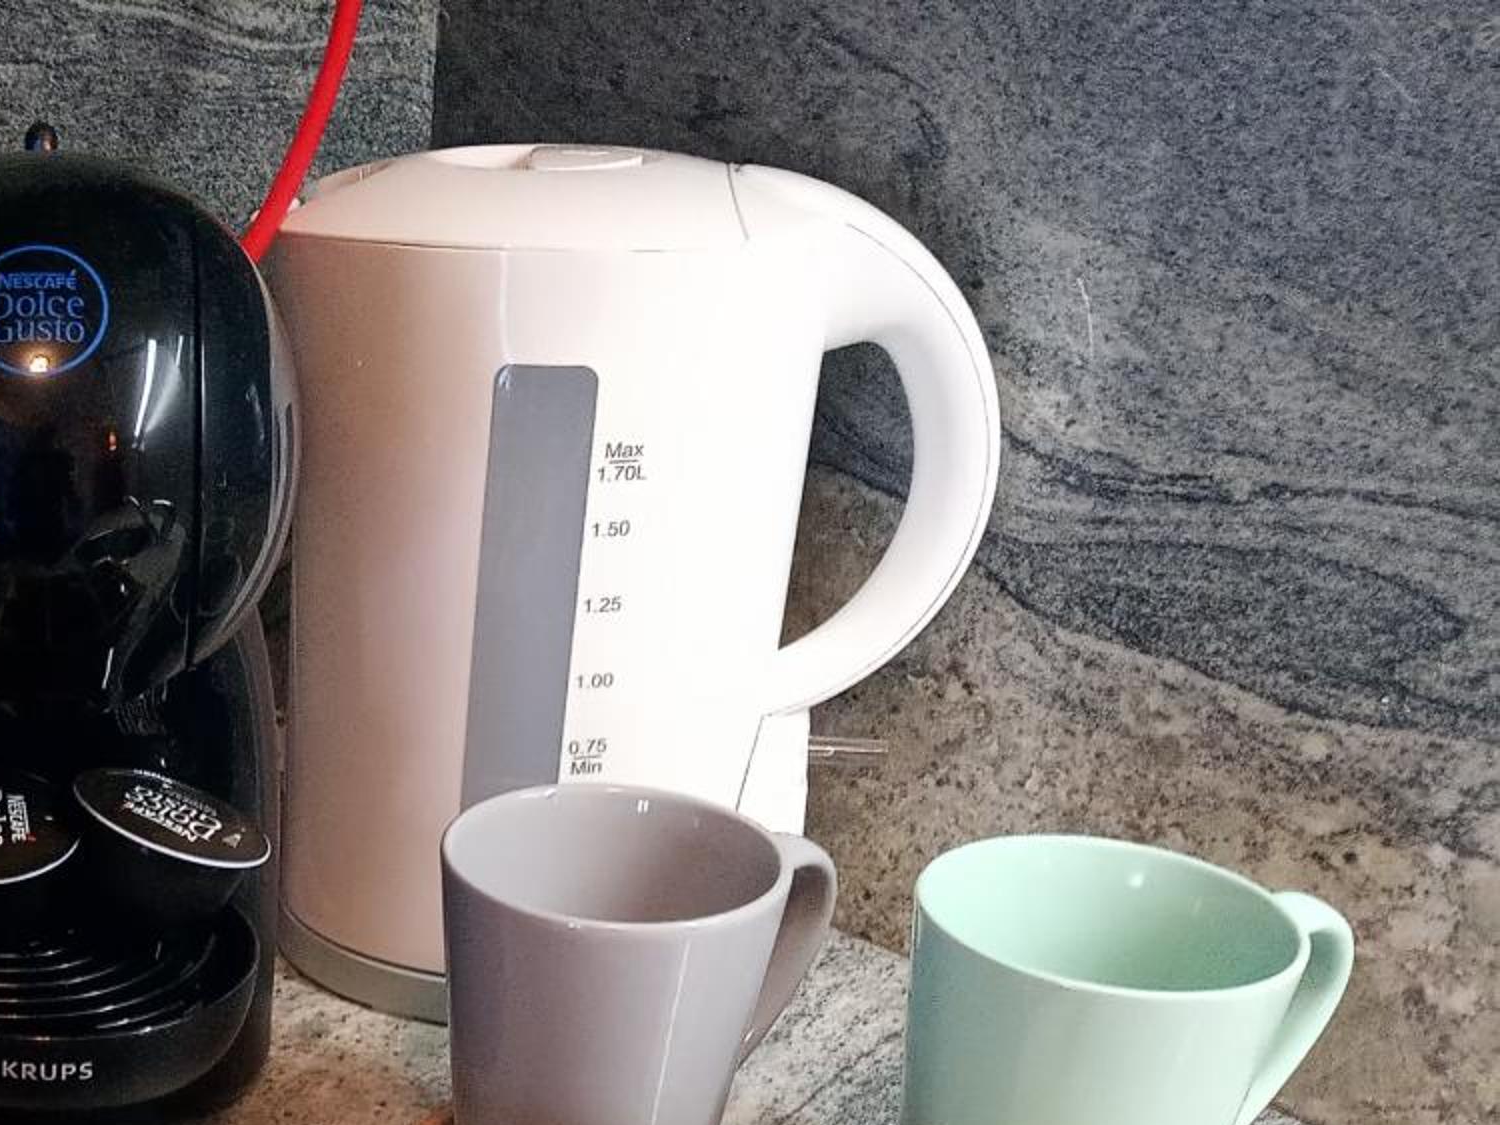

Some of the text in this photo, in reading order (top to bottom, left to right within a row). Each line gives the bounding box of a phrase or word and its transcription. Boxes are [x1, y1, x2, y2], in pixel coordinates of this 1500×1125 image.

[605, 441, 645, 459] Max
[597, 465, 647, 483] 1.70L
[592, 519, 631, 538] 1.50
[584, 595, 622, 613] 1.25
[576, 672, 614, 689] 1.00
[568, 738, 607, 755] 0.75
[570, 759, 603, 776] Min
[2, 1060, 93, 1081] KRUPS
